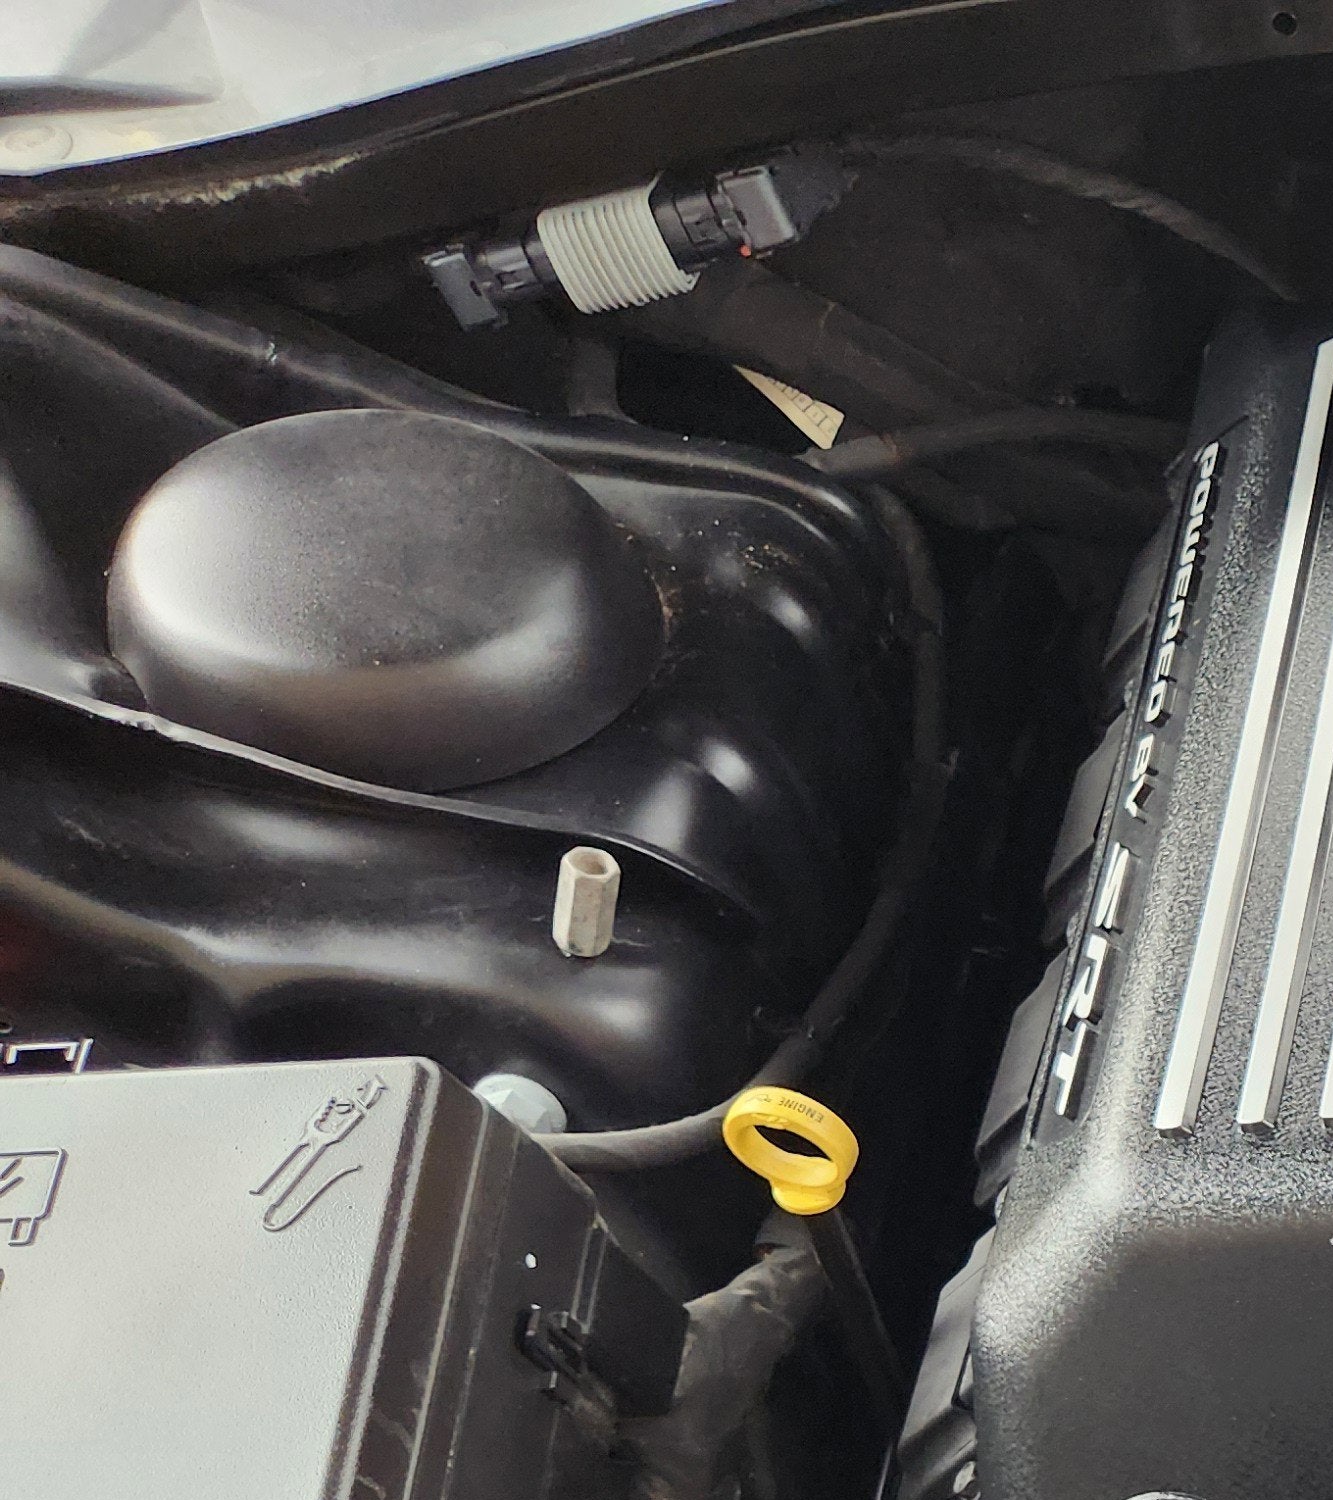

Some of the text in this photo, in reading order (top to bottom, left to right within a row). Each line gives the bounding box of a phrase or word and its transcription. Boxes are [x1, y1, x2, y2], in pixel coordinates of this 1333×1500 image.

[1055, 440, 1219, 1116] POWERED BY SRT
[778, 1096, 824, 1123] ENGINE
